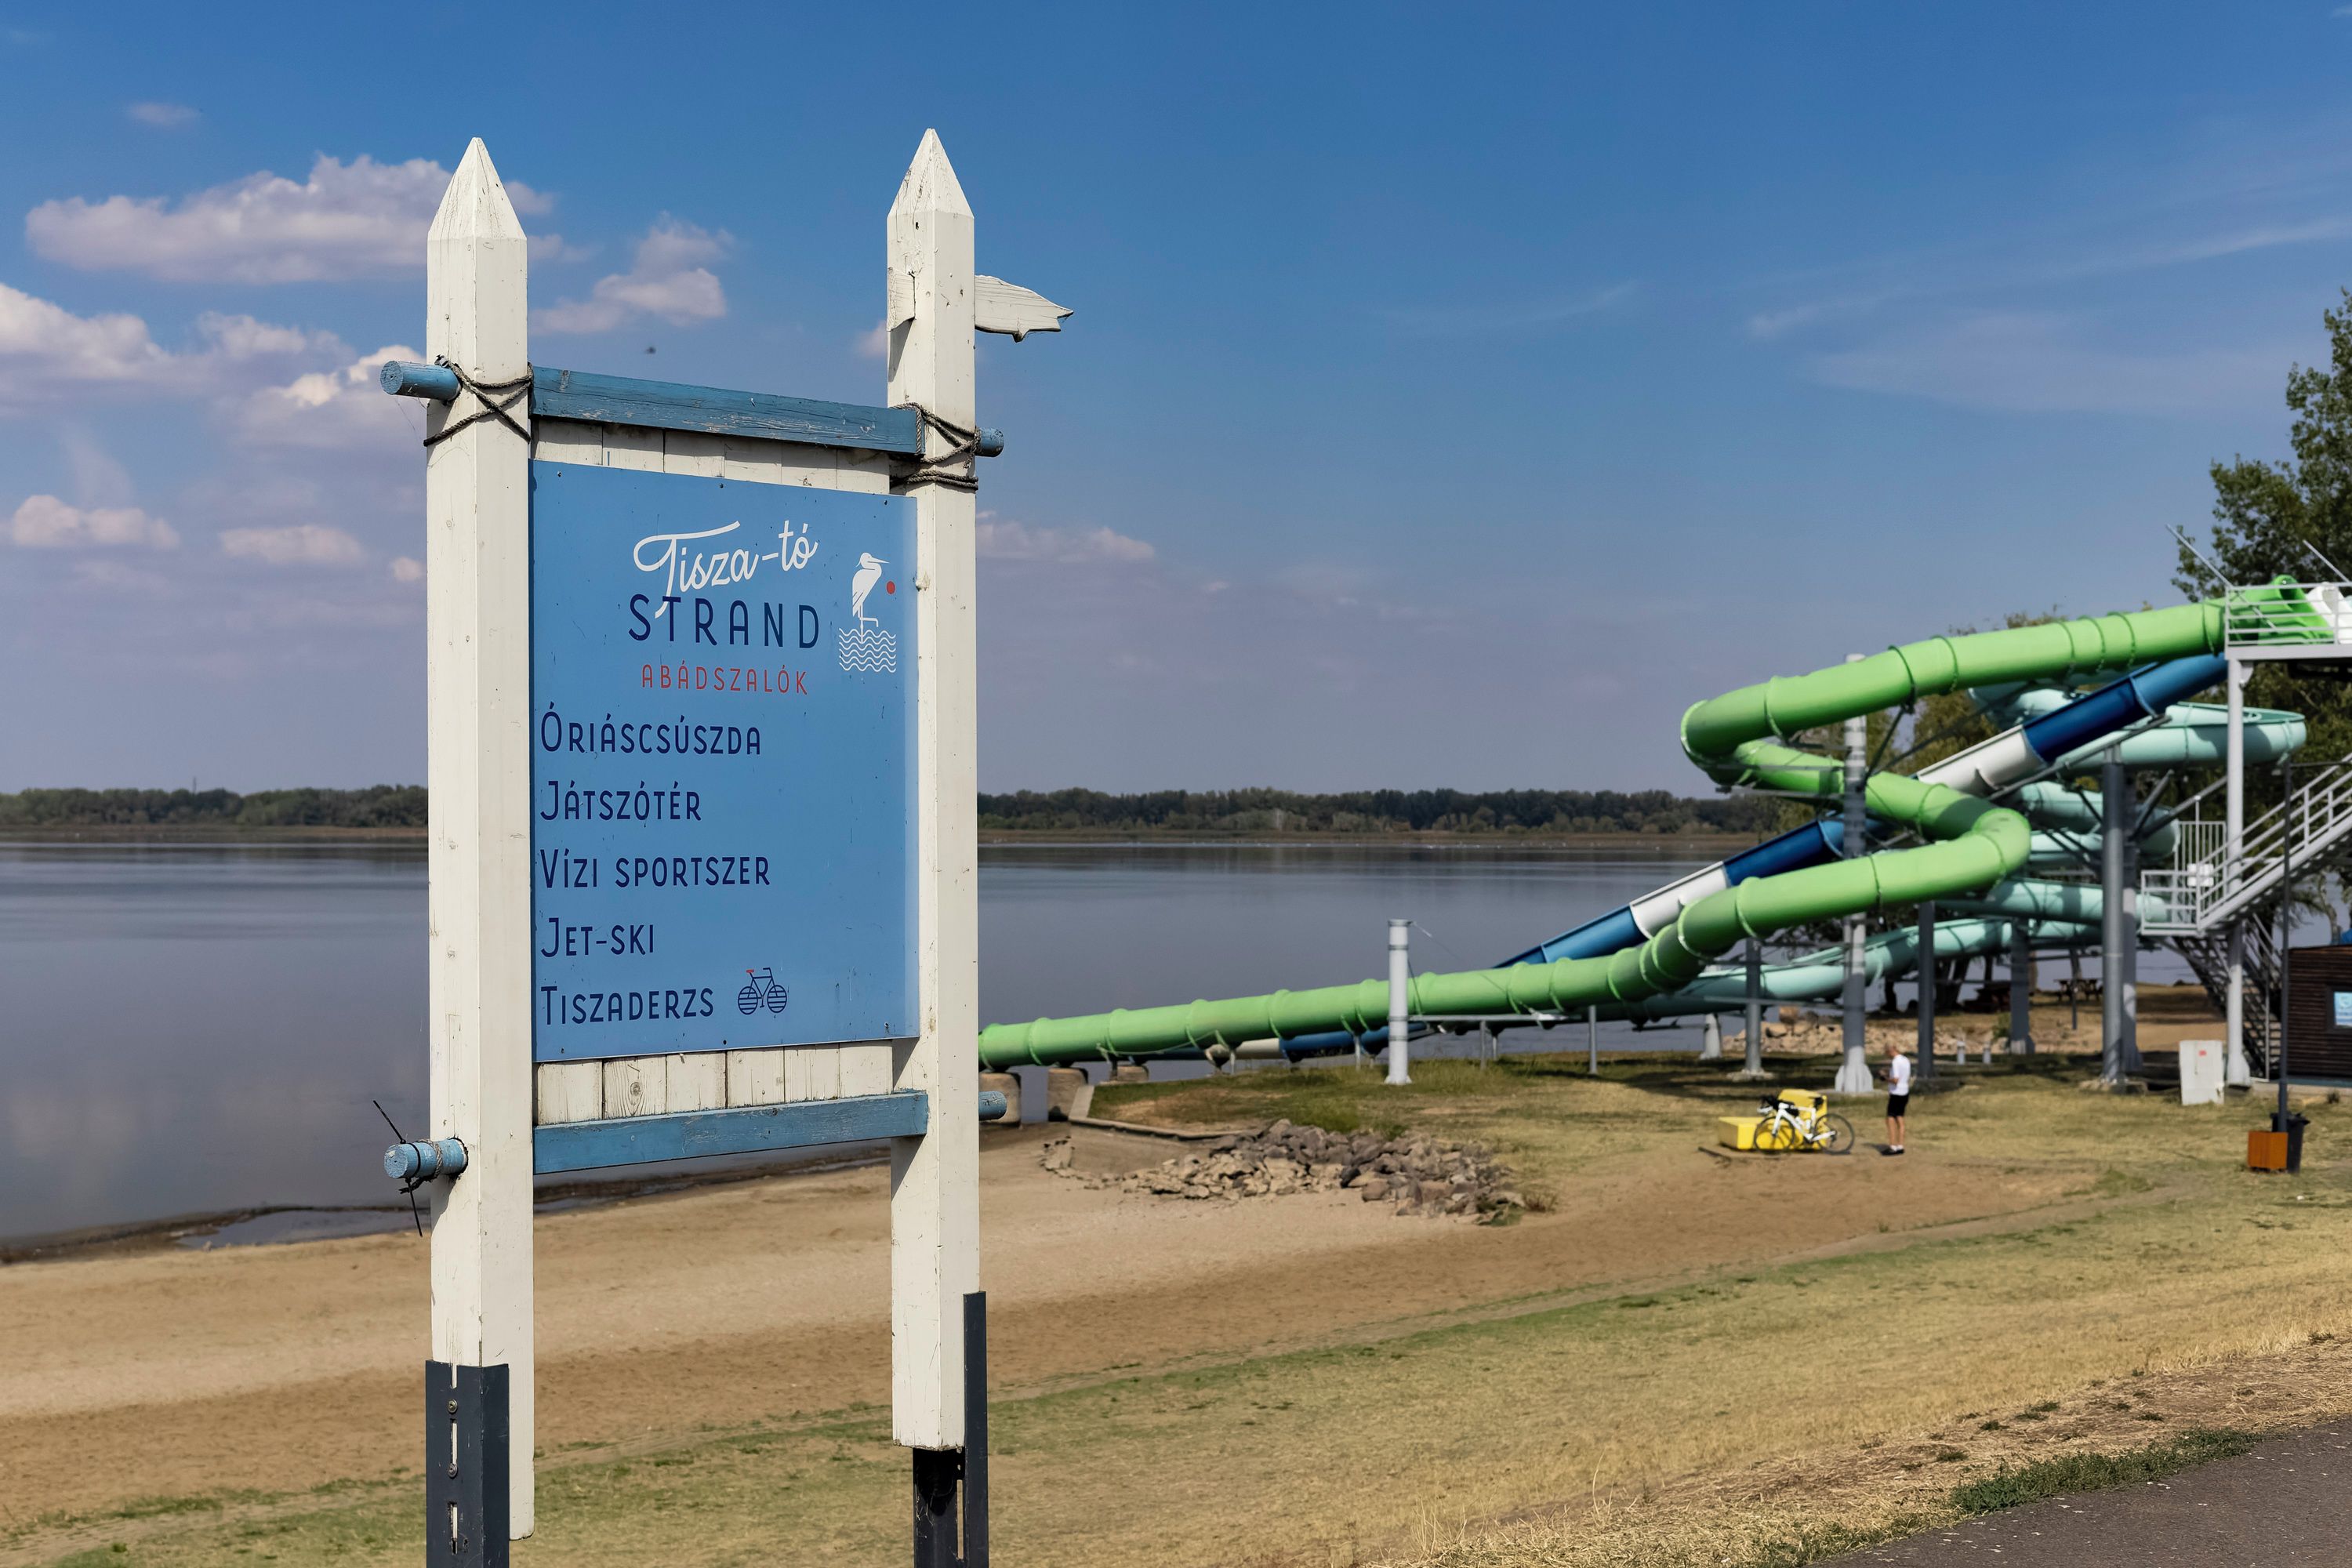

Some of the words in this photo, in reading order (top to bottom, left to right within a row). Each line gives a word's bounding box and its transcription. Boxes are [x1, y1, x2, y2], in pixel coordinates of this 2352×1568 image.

[633, 520, 818, 619] Tisza-tó
[628, 593, 819, 648] STRAND
[641, 660, 808, 695] ABÁDSZALÓK
[540, 701, 760, 755] ÓRIÁSCSÚSZDA
[539, 780, 702, 821] JÁTSZÓTÉR
[539, 848, 598, 888] VÍZI
[615, 856, 771, 887] SPORTSZER
[540, 917, 655, 957] JET-SKI
[540, 985, 714, 1025] TISZADERZS
